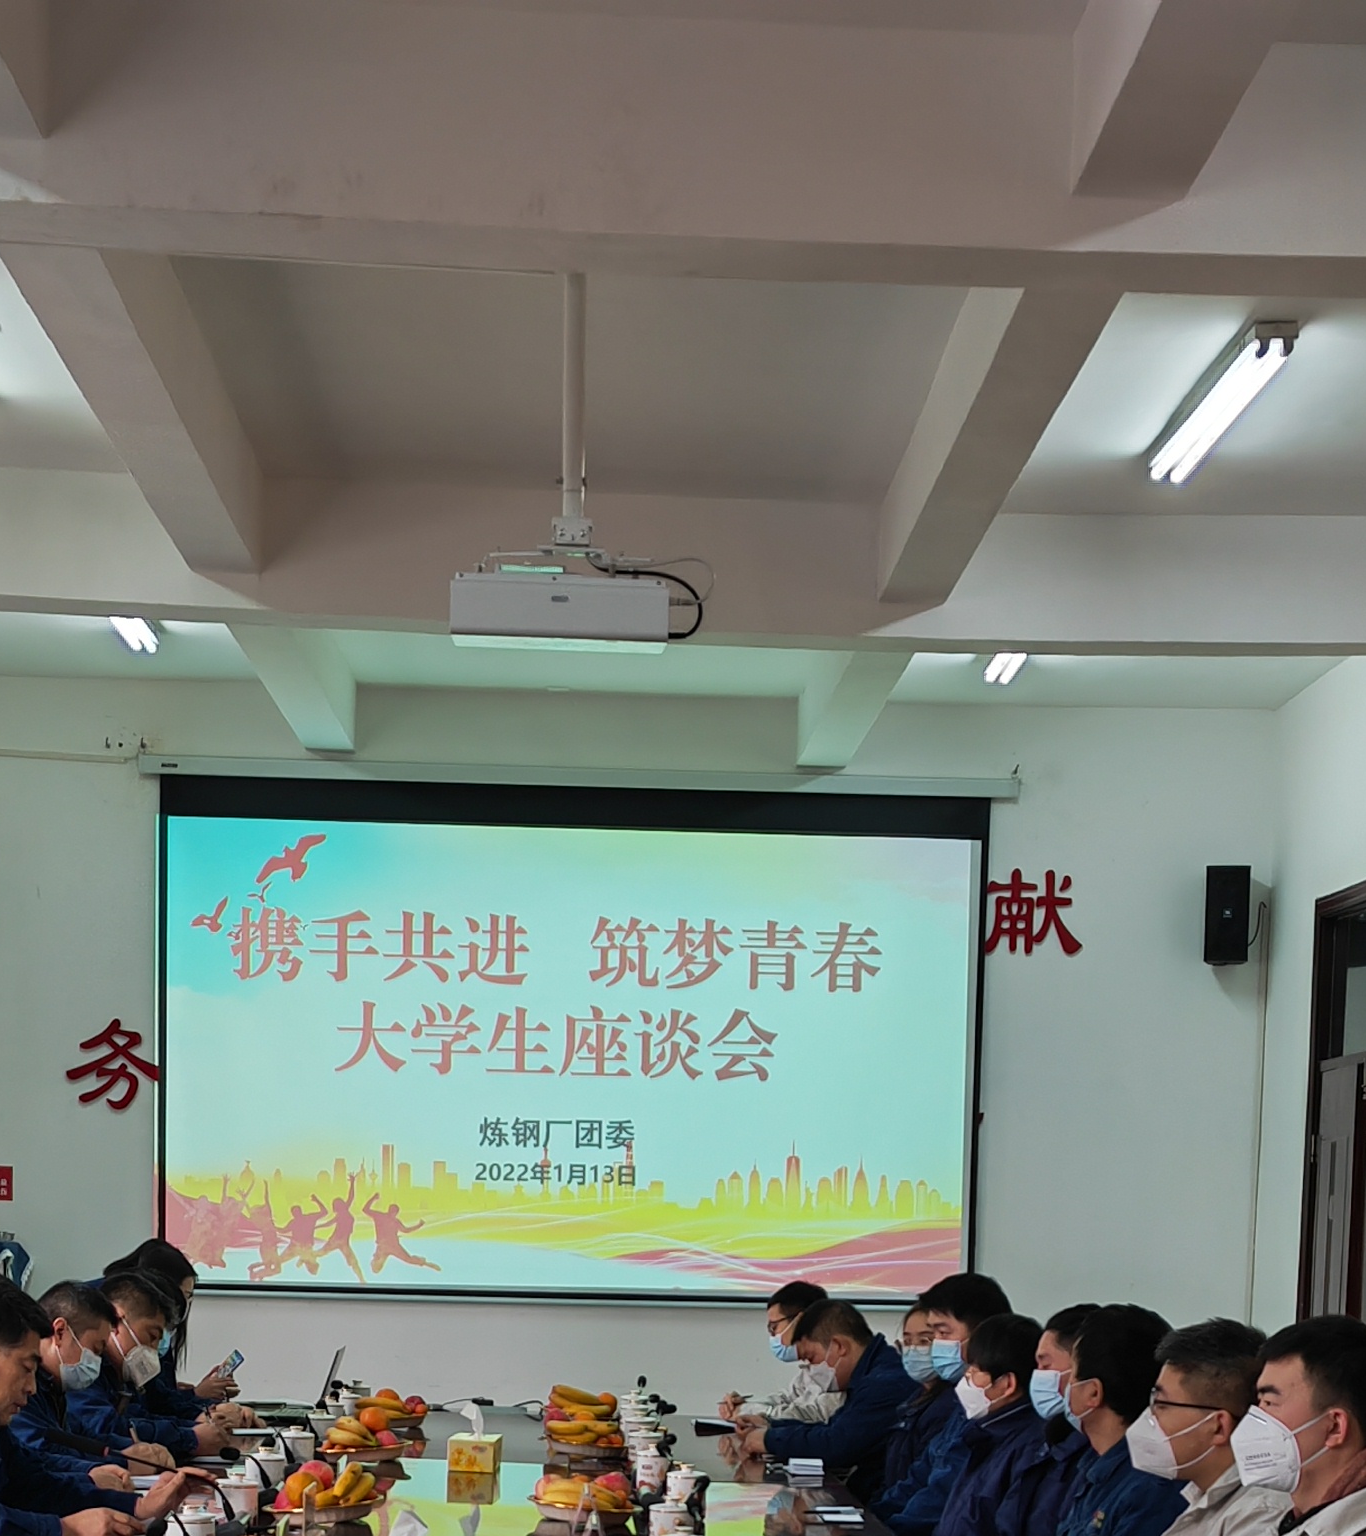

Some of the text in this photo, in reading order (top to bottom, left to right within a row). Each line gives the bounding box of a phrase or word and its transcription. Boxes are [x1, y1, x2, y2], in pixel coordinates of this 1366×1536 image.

[231, 905, 883, 994] 携手共进 筑梦青春
[985, 867, 1083, 957] 献
[65, 1018, 160, 1111] 务
[333, 1001, 780, 1083] 大学生座谈会
[474, 1162, 638, 1189] 2022年1月13日
[478, 1117, 636, 1152] 炼钢厂团委
